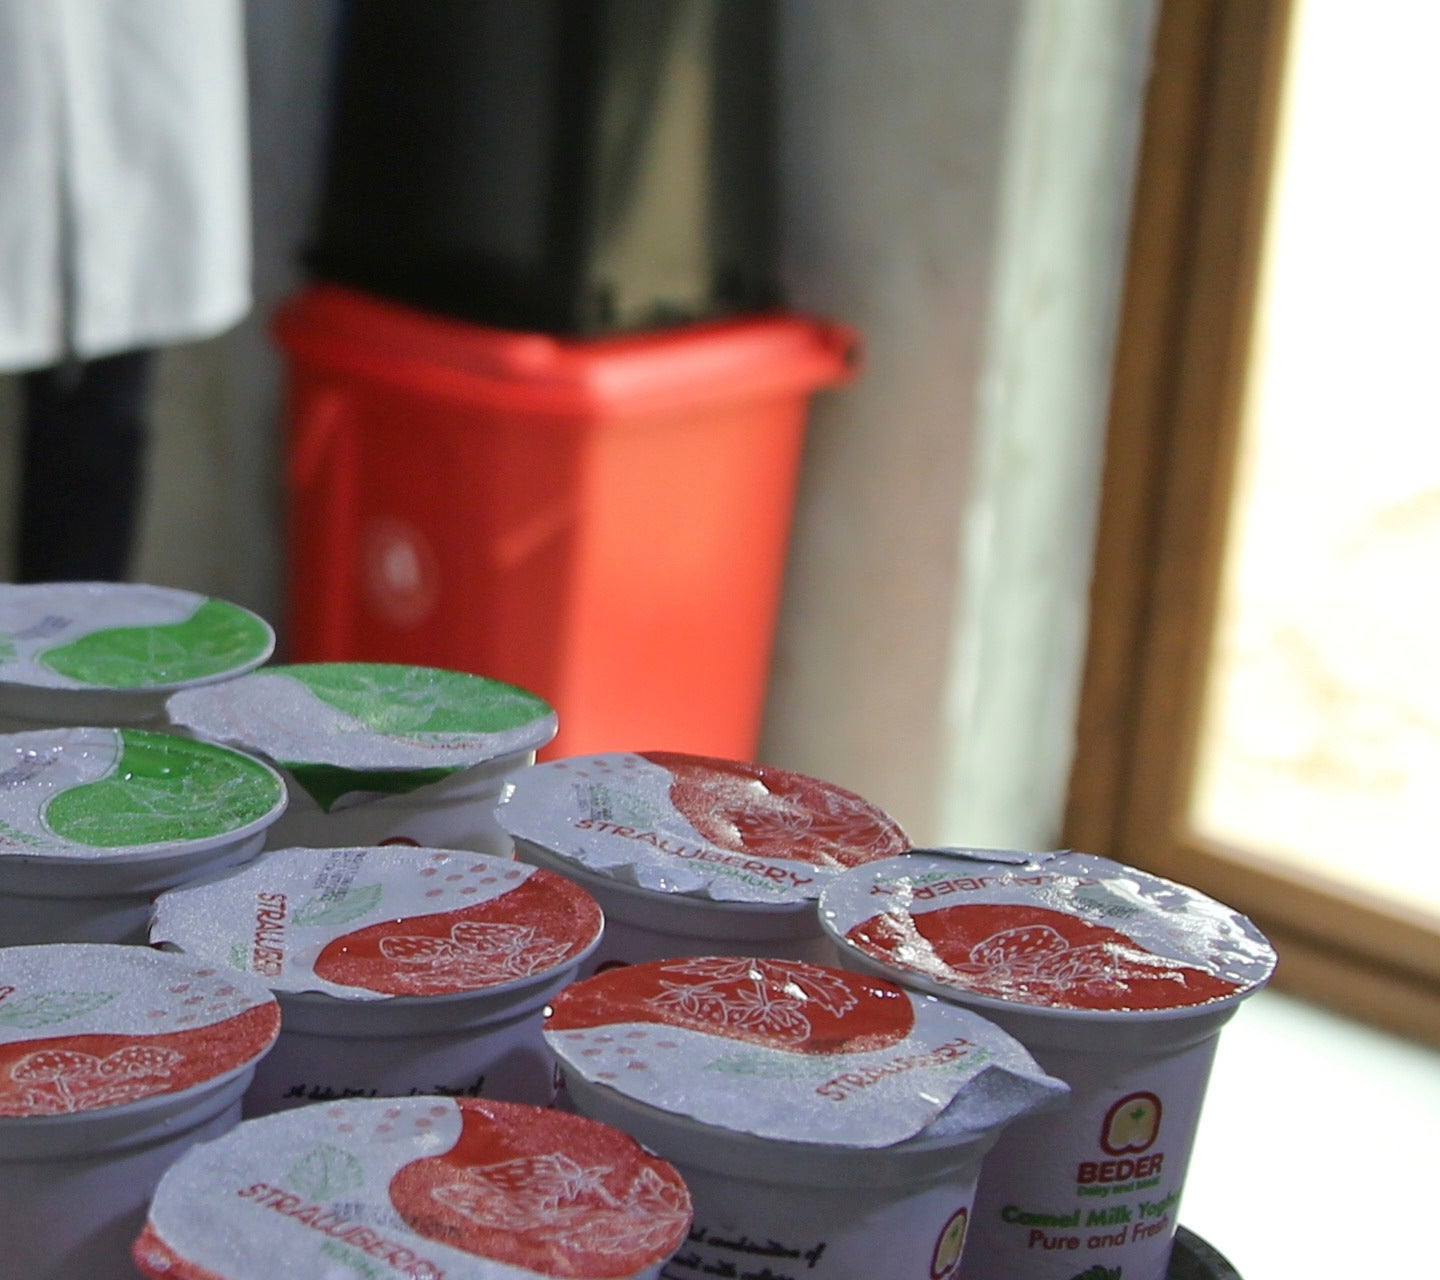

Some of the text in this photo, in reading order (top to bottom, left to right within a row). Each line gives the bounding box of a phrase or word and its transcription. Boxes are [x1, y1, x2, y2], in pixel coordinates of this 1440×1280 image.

[573, 819, 814, 889] STRAWBERRY
[1076, 1152, 1165, 1184] BEDER
[1002, 1204, 1081, 1228] Camel
[1086, 1204, 1132, 1228] Milk
[1028, 1229, 1081, 1251] Pure
[1087, 1227, 1127, 1250] and
